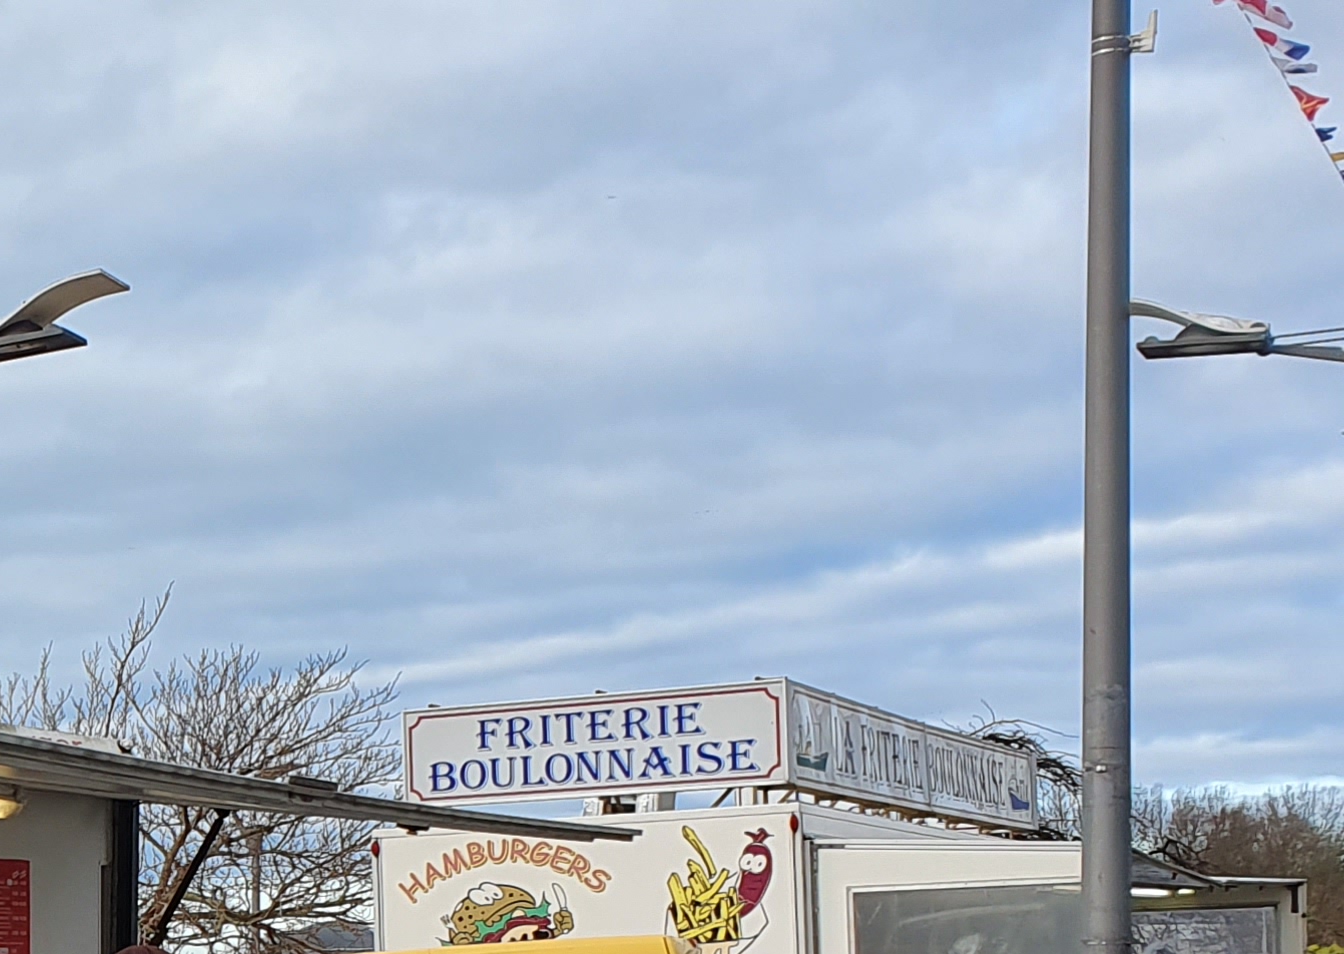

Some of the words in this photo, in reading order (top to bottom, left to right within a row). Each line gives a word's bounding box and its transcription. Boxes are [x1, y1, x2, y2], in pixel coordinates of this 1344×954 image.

[477, 702, 705, 751] FRITERIE
[428, 738, 761, 793] BOULONNAISE
[834, 715, 859, 776] LA
[861, 725, 923, 790] FRITERIE
[926, 742, 1007, 808] BOULONNAISE
[398, 838, 612, 904] HAMBURGERS
